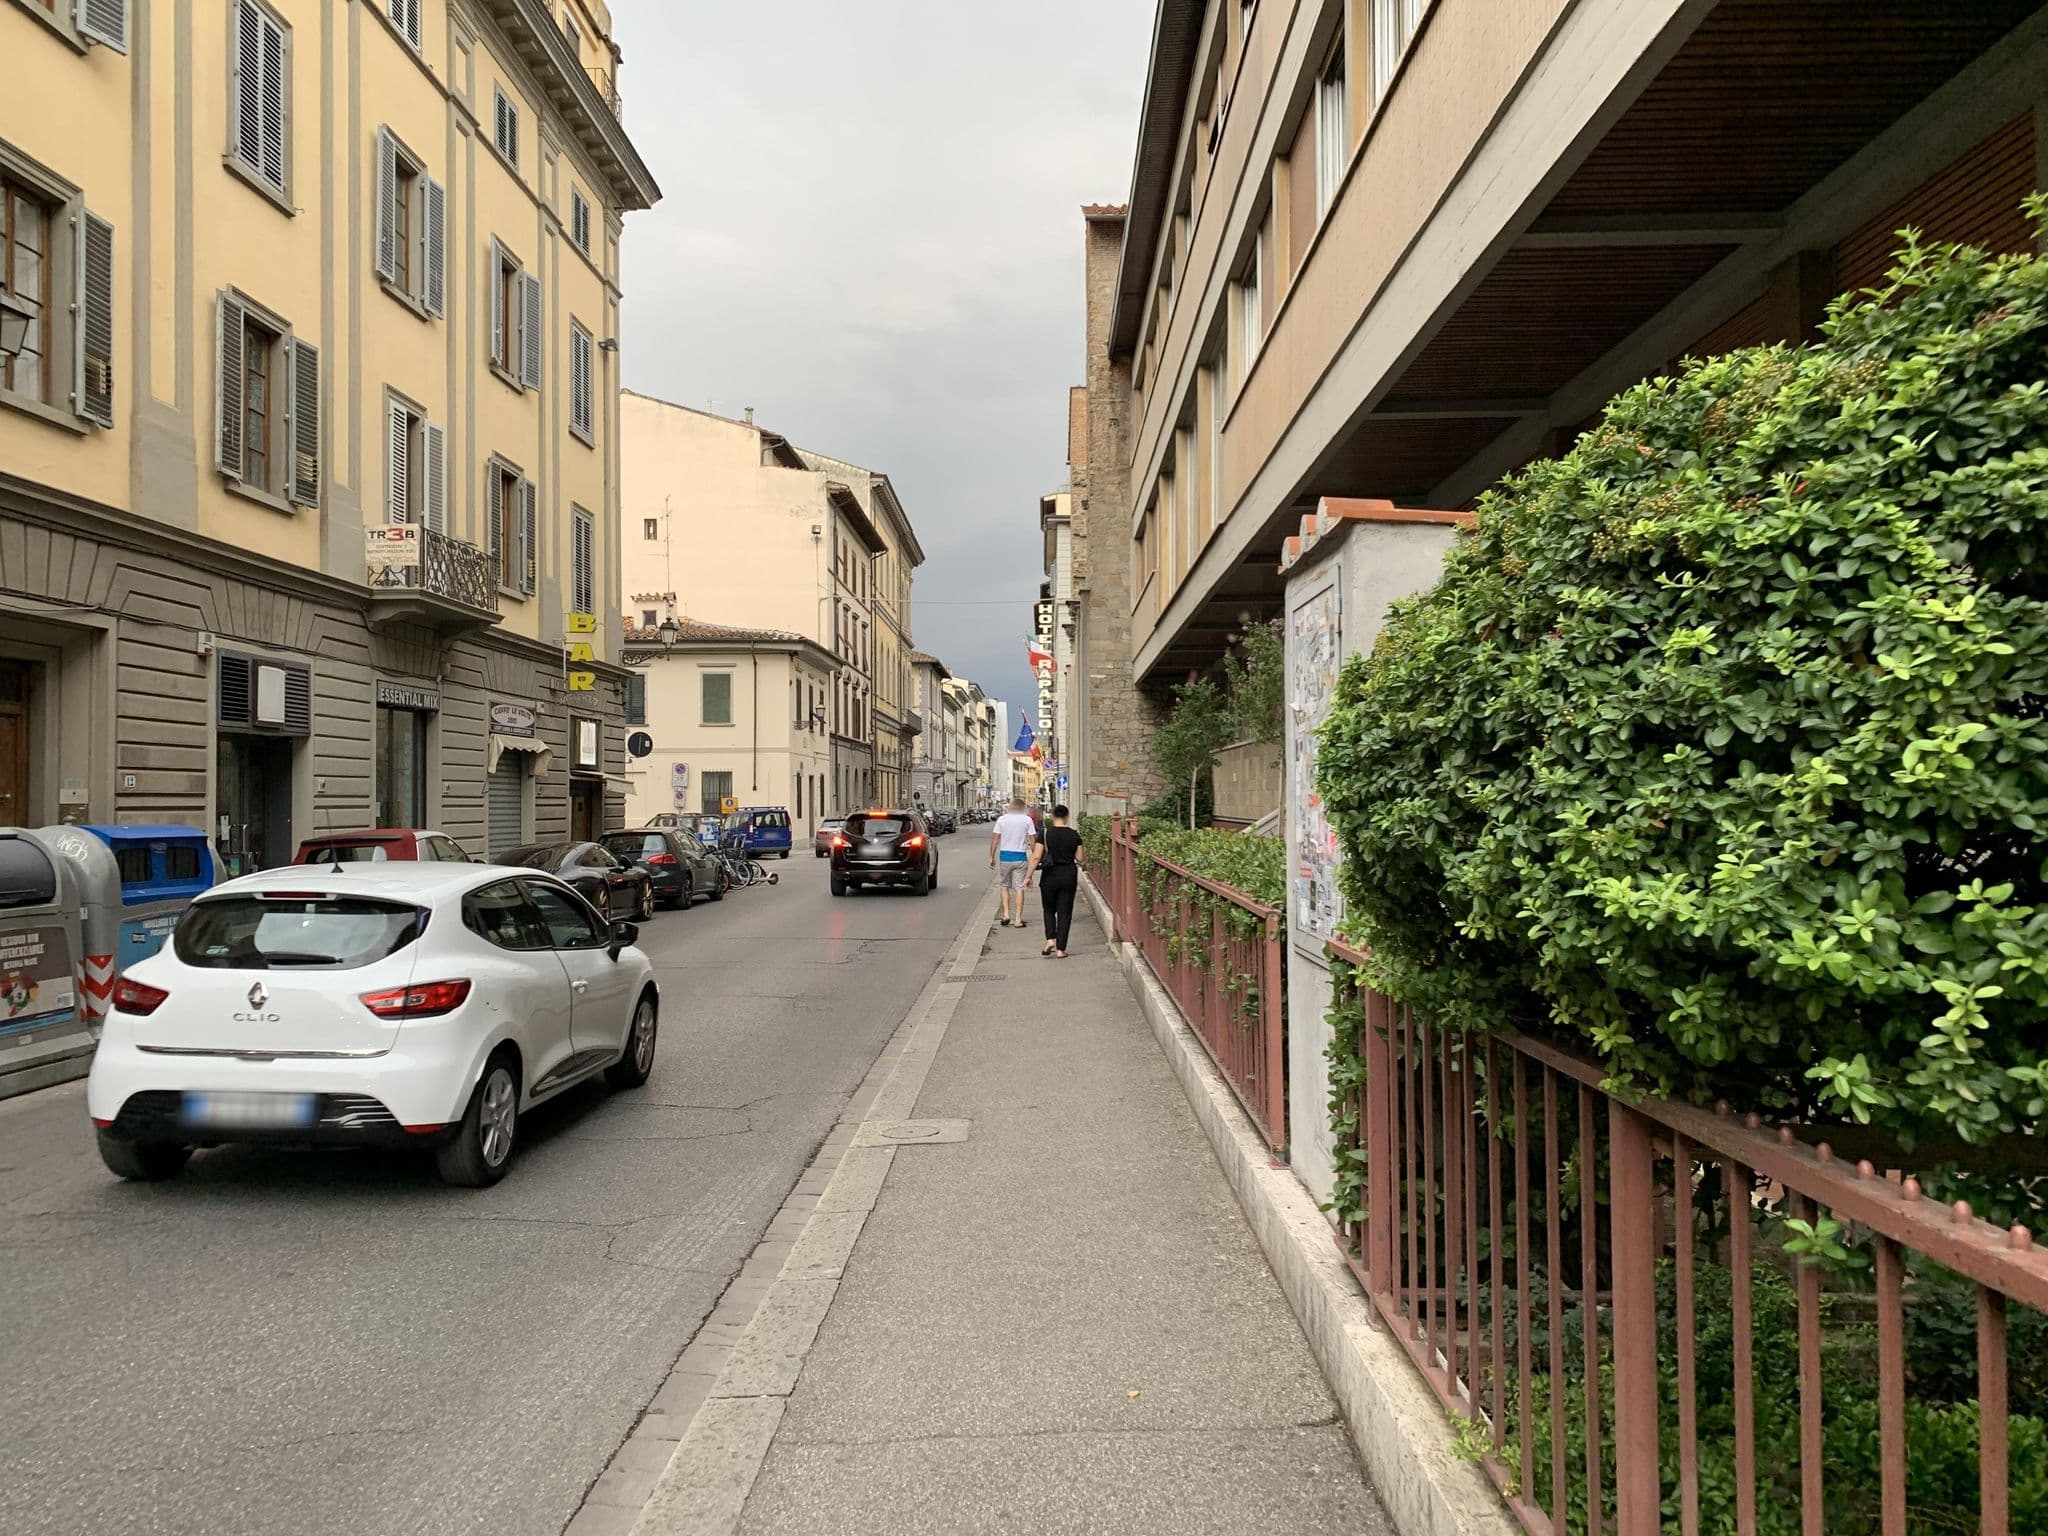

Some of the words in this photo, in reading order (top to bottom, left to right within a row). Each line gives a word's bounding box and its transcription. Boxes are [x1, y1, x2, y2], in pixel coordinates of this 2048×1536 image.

[368, 528, 415, 541] TR3B
[1038, 604, 1053, 654] HOTEL
[569, 613, 597, 691] BAR
[380, 687, 422, 707] ESSENTIAL
[424, 694, 440, 710] MIX
[1038, 659, 1053, 729] RAPALLO
[232, 1012, 280, 1023] CLIO
